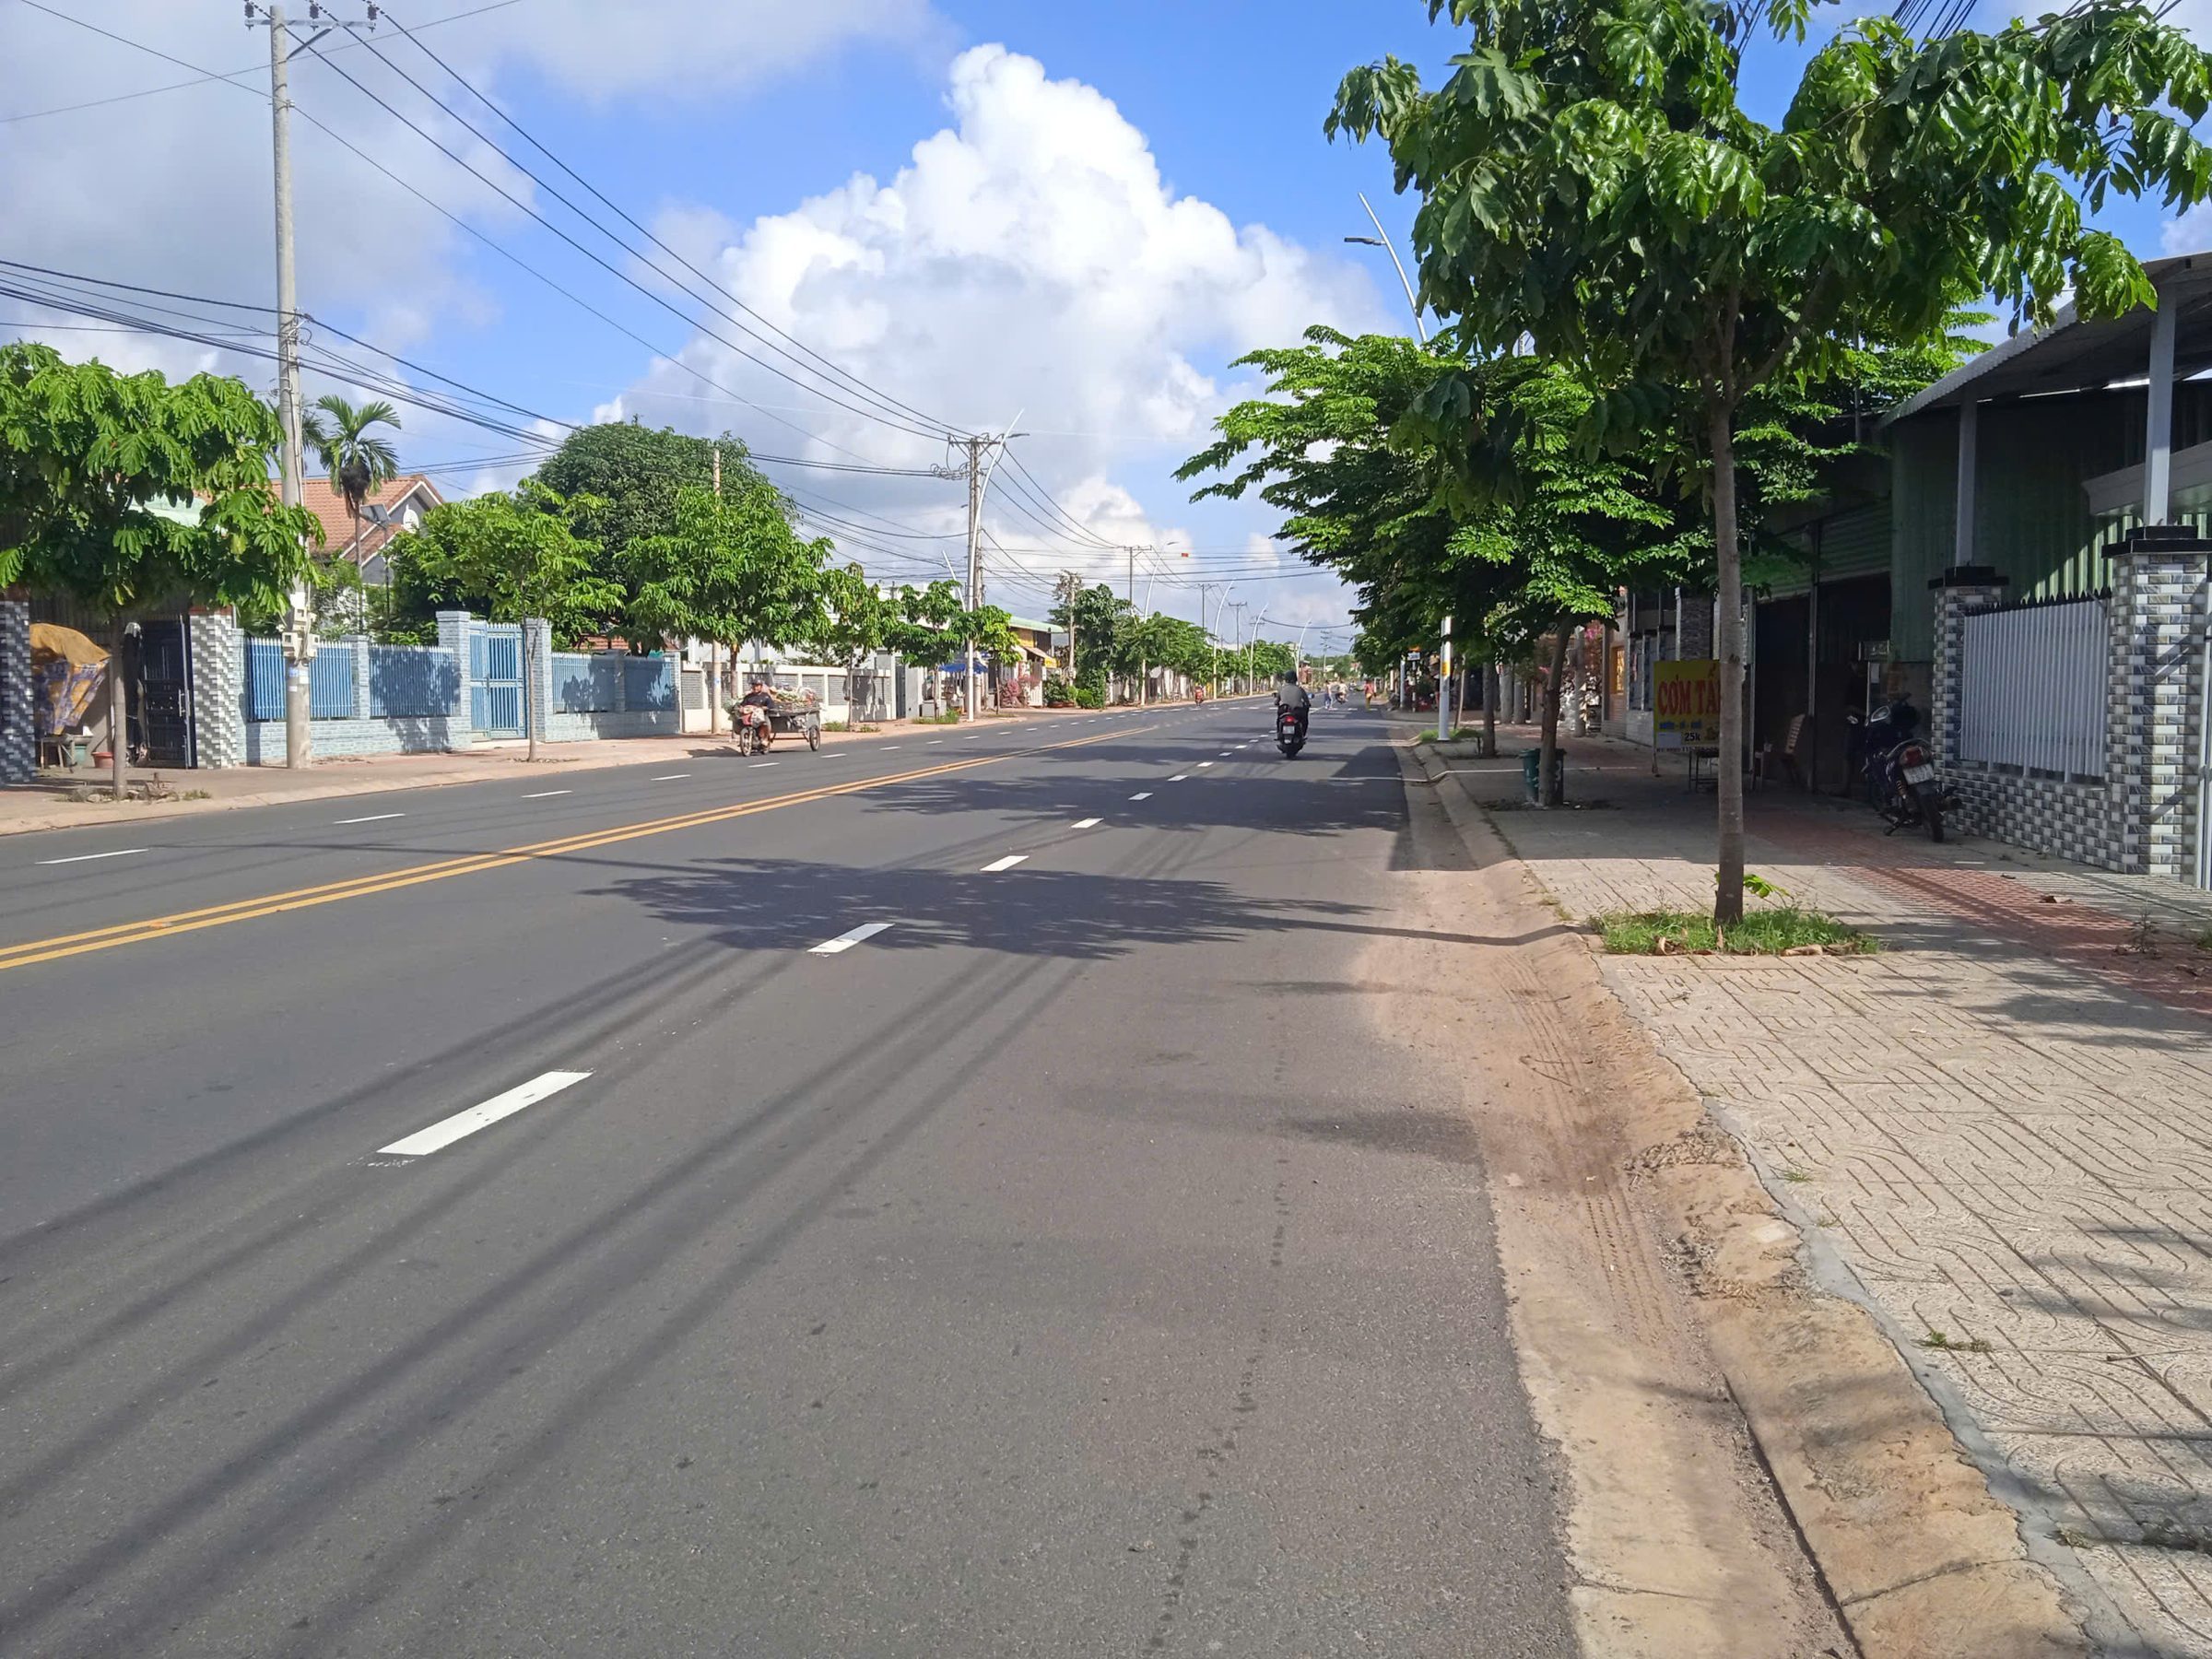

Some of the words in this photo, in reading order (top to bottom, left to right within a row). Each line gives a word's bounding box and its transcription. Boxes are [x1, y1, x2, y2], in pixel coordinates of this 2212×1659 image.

[1658, 675, 1692, 715] CƠM
[1697, 664, 1721, 715] TẤ
[1685, 732, 1700, 741] 25k
